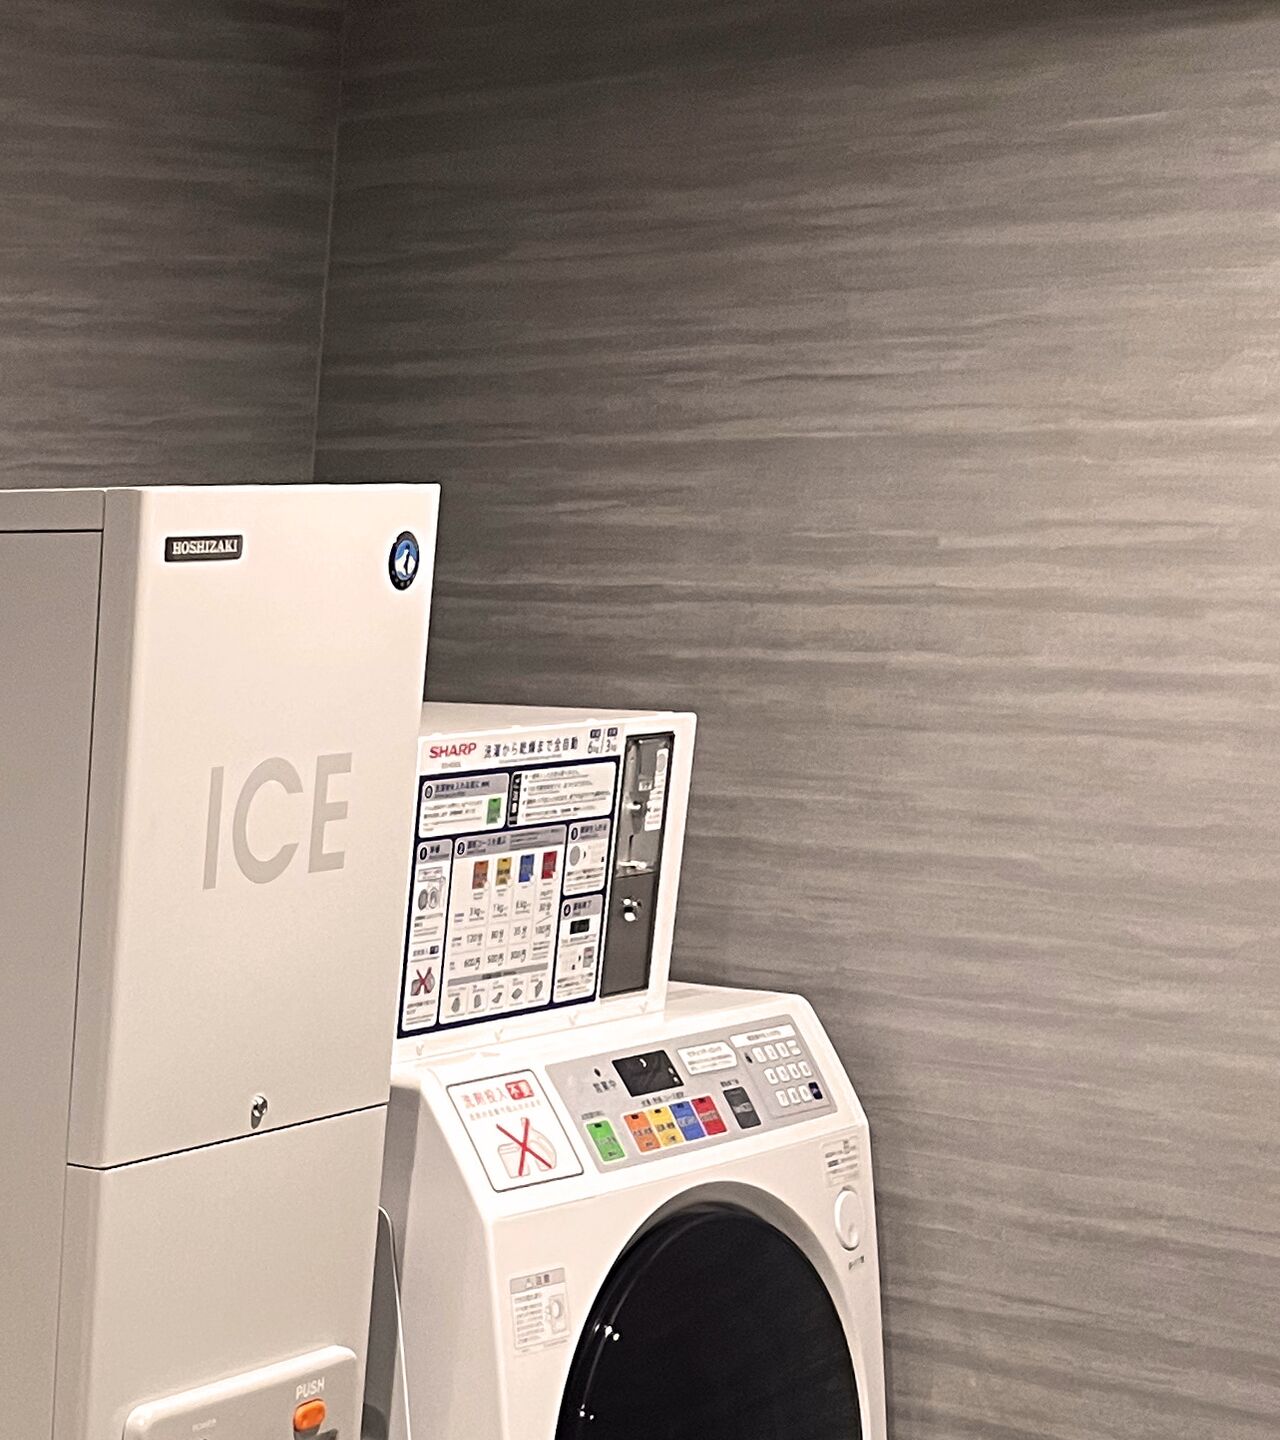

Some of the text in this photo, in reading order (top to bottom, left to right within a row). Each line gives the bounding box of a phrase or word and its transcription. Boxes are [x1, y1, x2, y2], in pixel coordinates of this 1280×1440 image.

[172, 540, 238, 554] HOSHIZAKI
[429, 742, 477, 759] SHARP
[202, 752, 353, 891] ICE
[295, 1377, 325, 1400] PUSH
